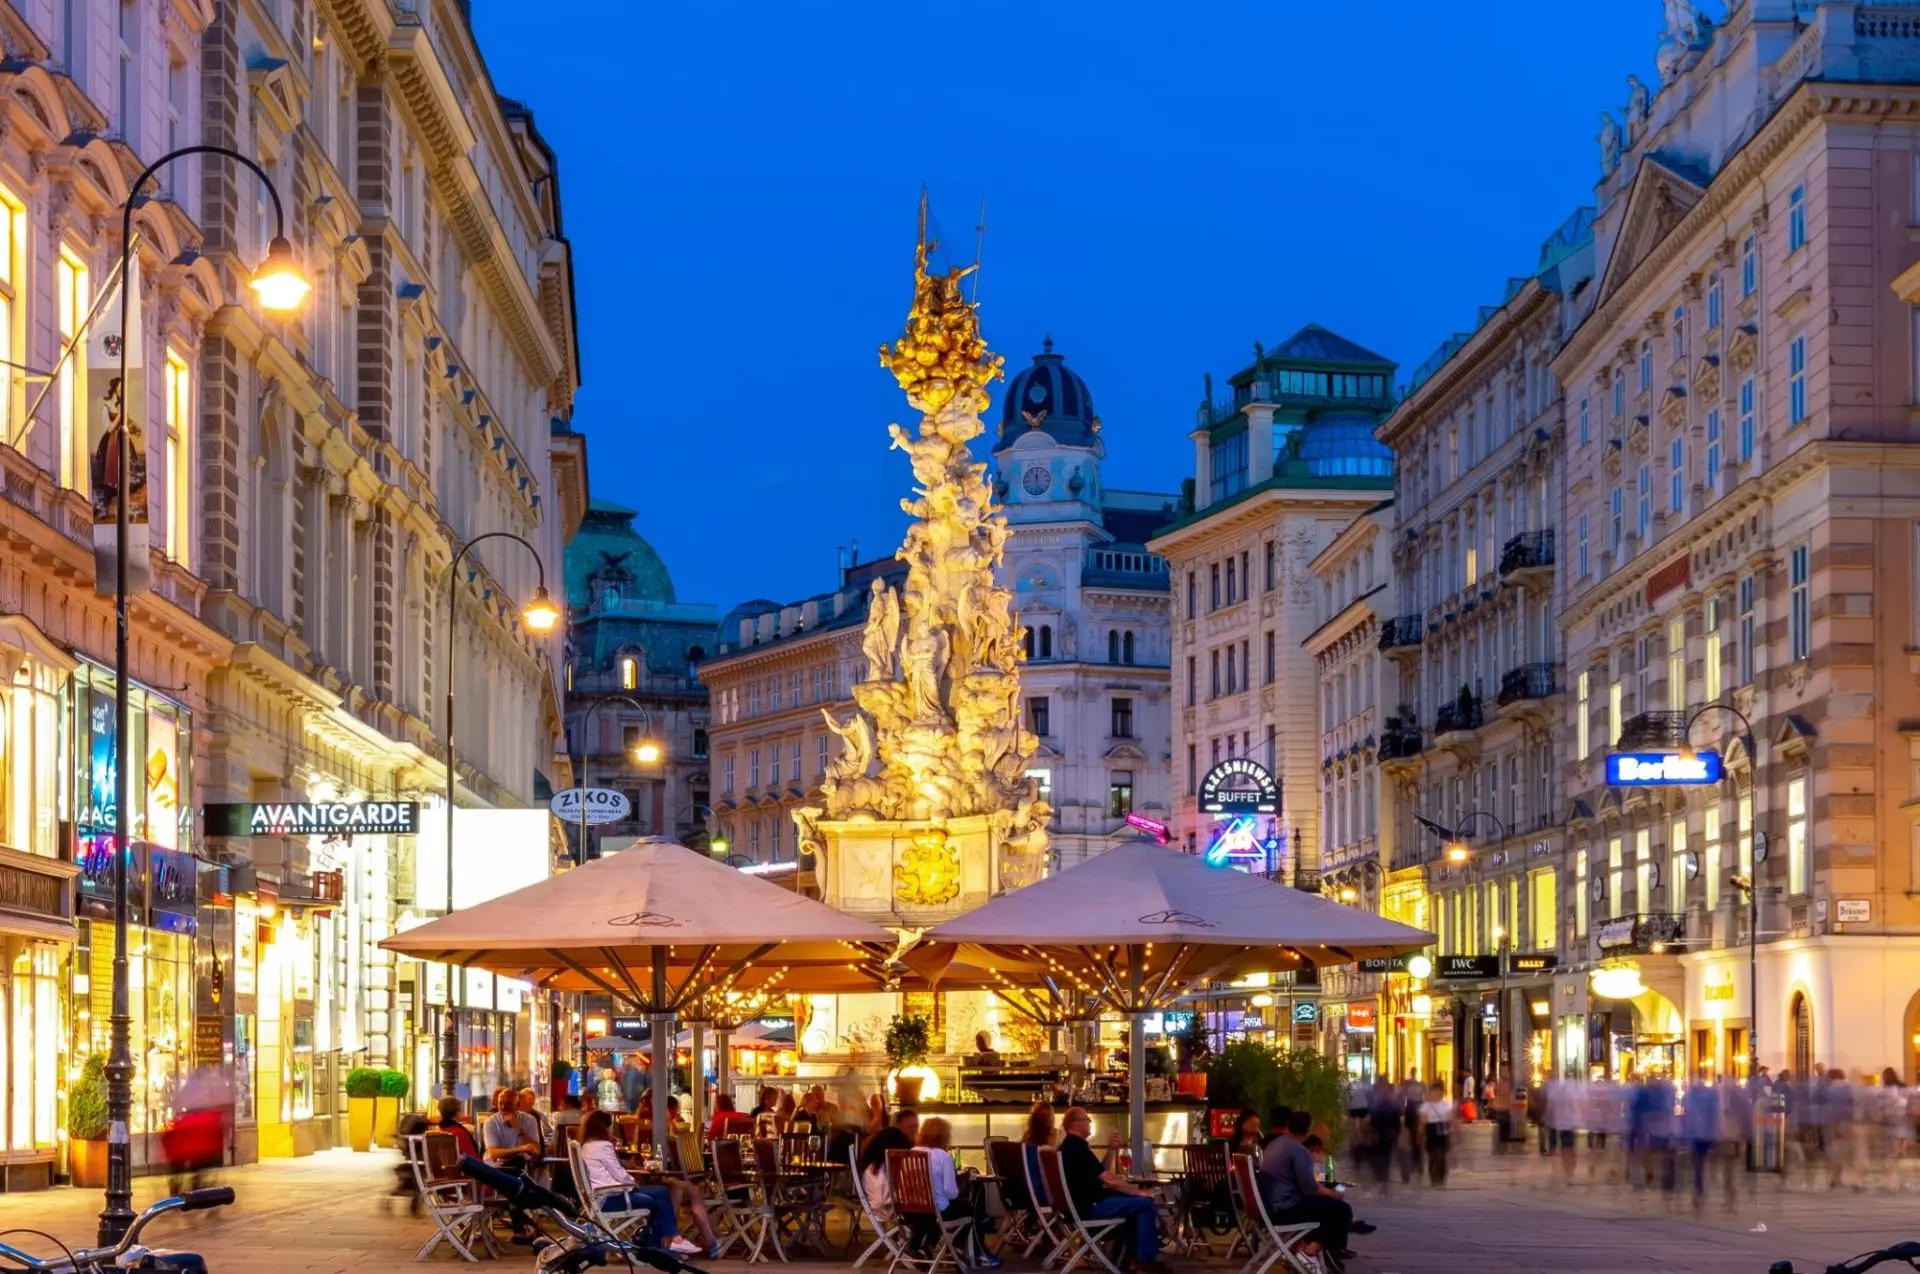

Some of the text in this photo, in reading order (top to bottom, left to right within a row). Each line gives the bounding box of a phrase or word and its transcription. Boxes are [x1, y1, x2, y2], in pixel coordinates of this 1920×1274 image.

[561, 791, 621, 807] ZIKOS
[1218, 792, 1261, 803] BUFFET
[251, 803, 410, 826] AVANTGARDE
[1366, 958, 1404, 968] BONITA
[1452, 959, 1475, 969] IWC
